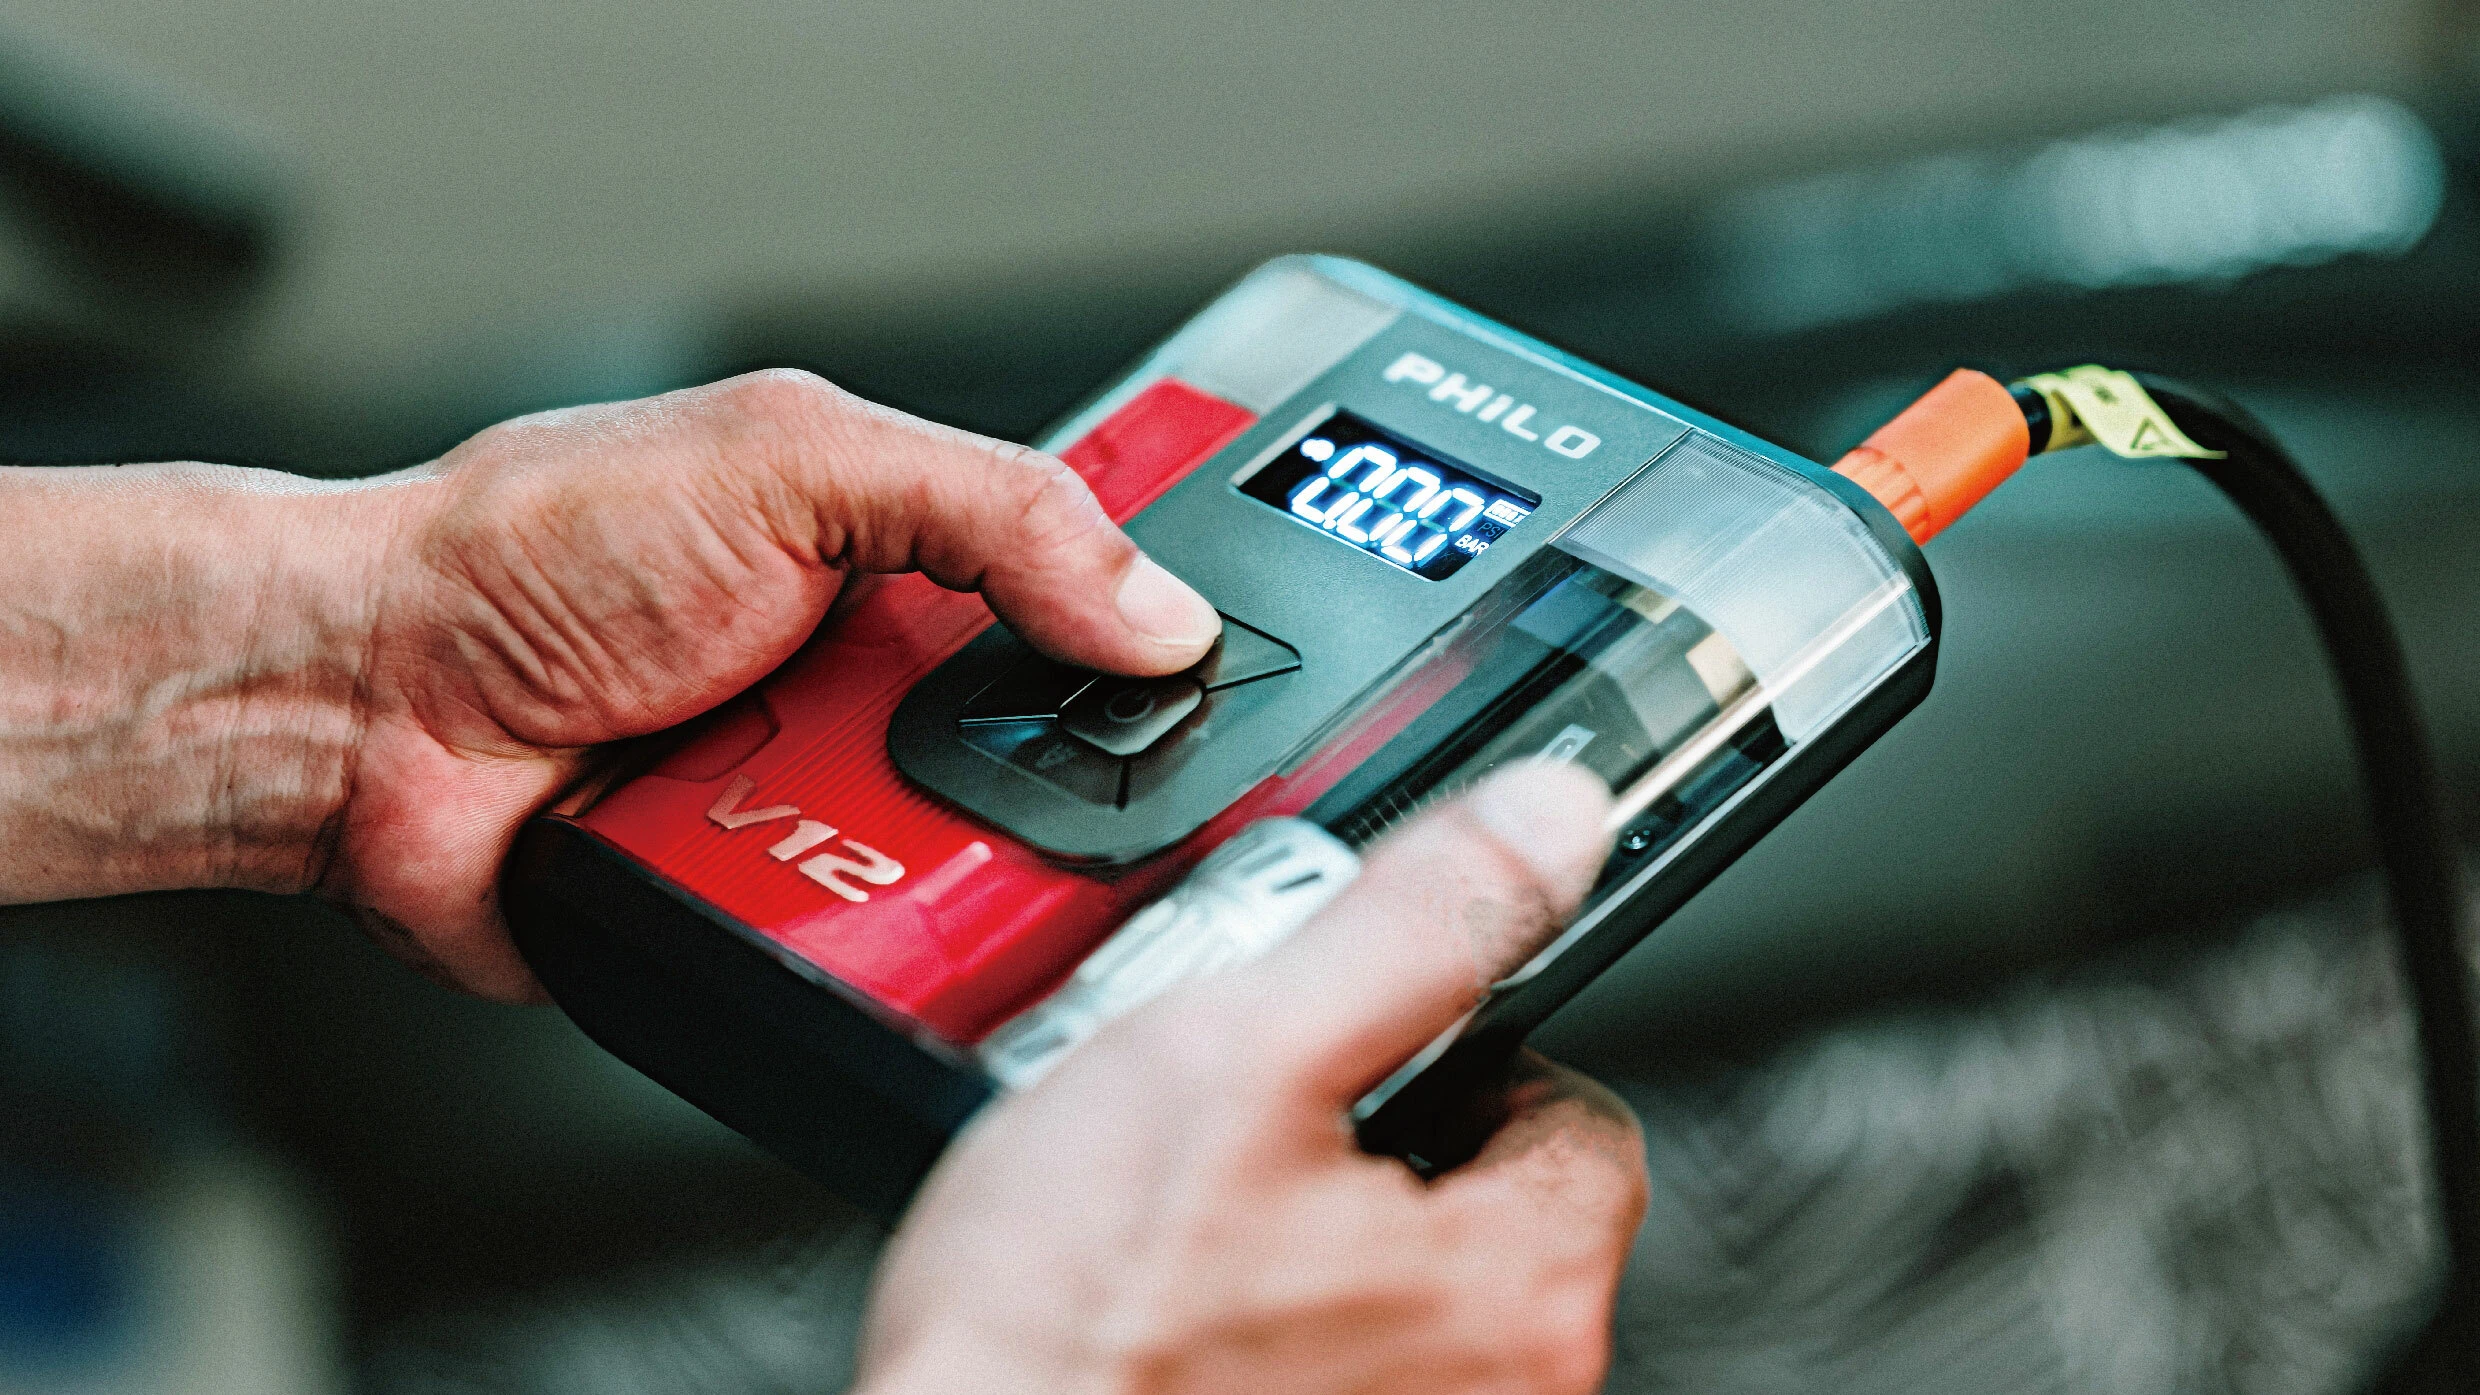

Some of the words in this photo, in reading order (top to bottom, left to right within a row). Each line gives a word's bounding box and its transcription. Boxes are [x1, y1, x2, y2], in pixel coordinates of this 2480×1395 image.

[1383, 352, 1602, 460] PHILO
[1454, 534, 1490, 556] BAR
[1476, 521, 1505, 539] PSI
[706, 774, 906, 903] V12
